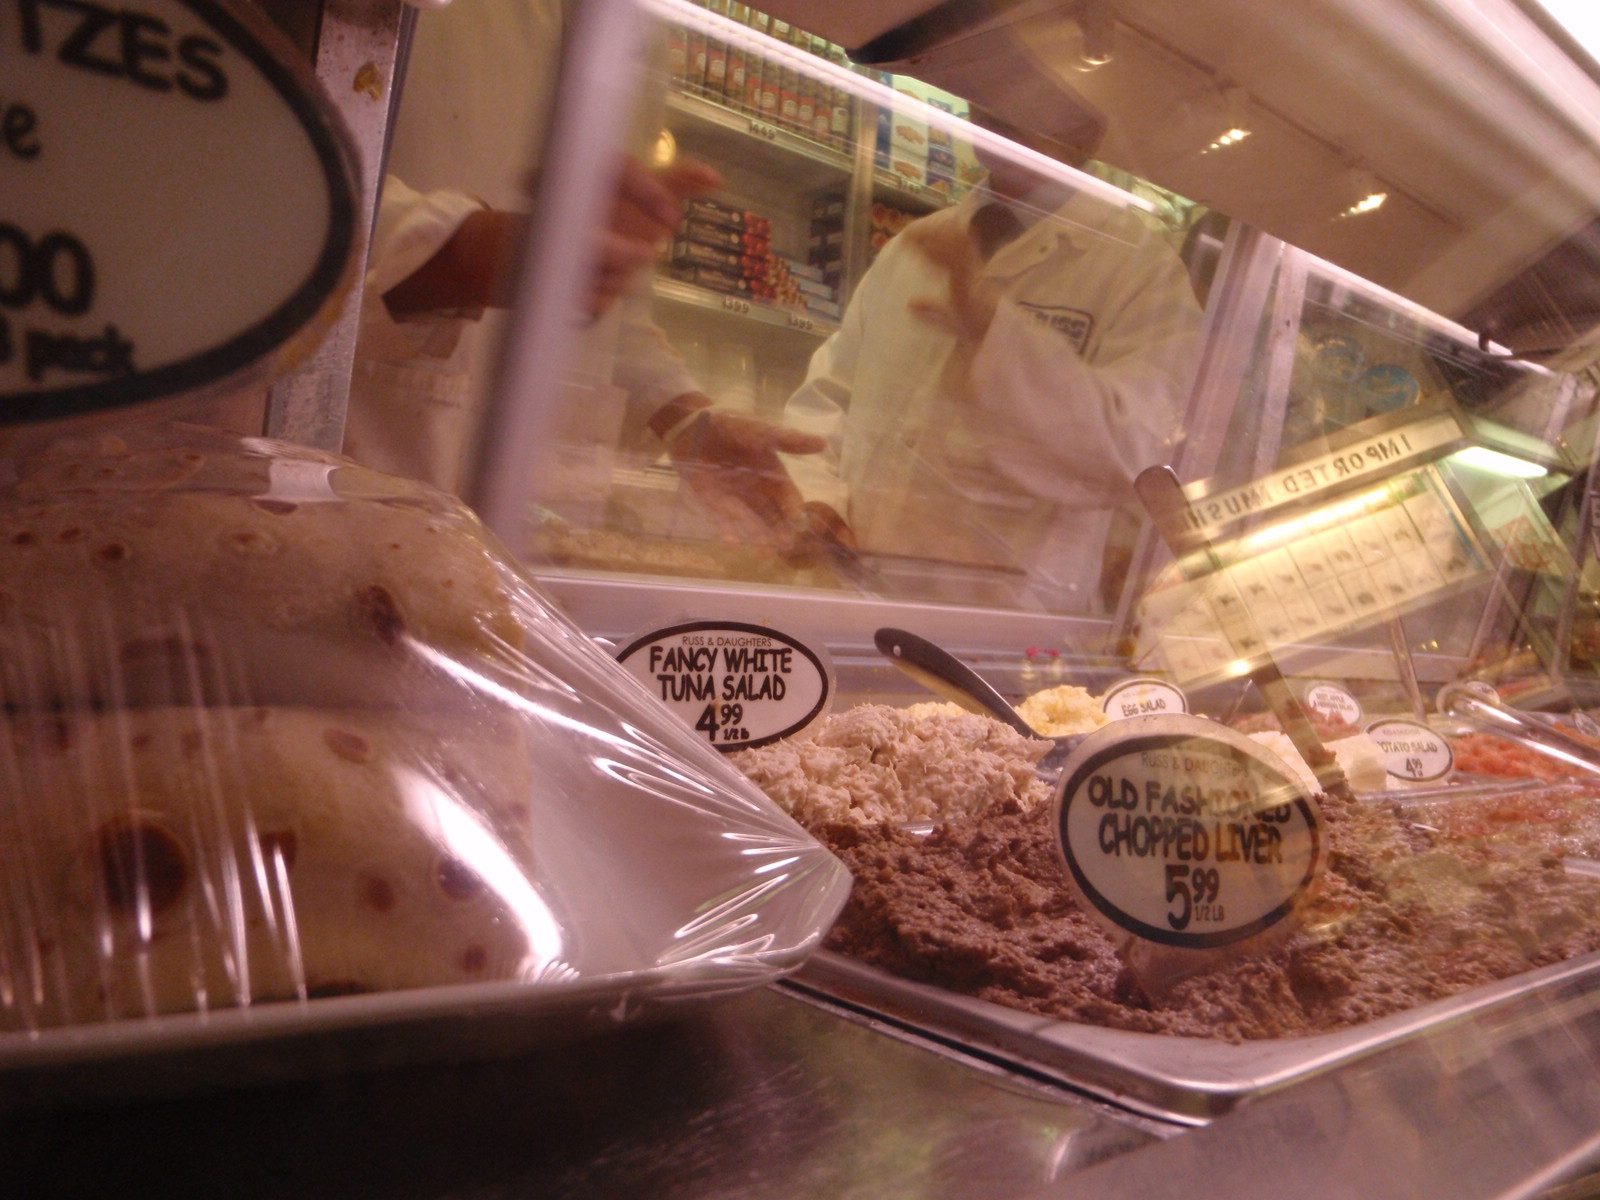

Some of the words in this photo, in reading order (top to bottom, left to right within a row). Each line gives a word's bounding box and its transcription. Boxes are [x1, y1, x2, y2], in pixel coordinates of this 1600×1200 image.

[682, 636, 704, 646] RUSS
[707, 637, 714, 646] &
[717, 636, 772, 647] DAUGHTERS
[649, 646, 718, 673] FANCY
[724, 647, 792, 673] WHITE
[657, 674, 716, 701] TUNA
[722, 674, 786, 701] SALAD
[1121, 704, 1139, 717] EGG
[1141, 698, 1166, 713] SALAD
[1376, 740, 1410, 753] OTATO
[1411, 741, 1438, 753] SALAD
[1088, 775, 1138, 810] OLD
[1099, 813, 1209, 862] CHOPPED
[1215, 822, 1283, 864] LIVER
[1195, 905, 1209, 922] 1/2
[1213, 906, 1225, 922] LB
